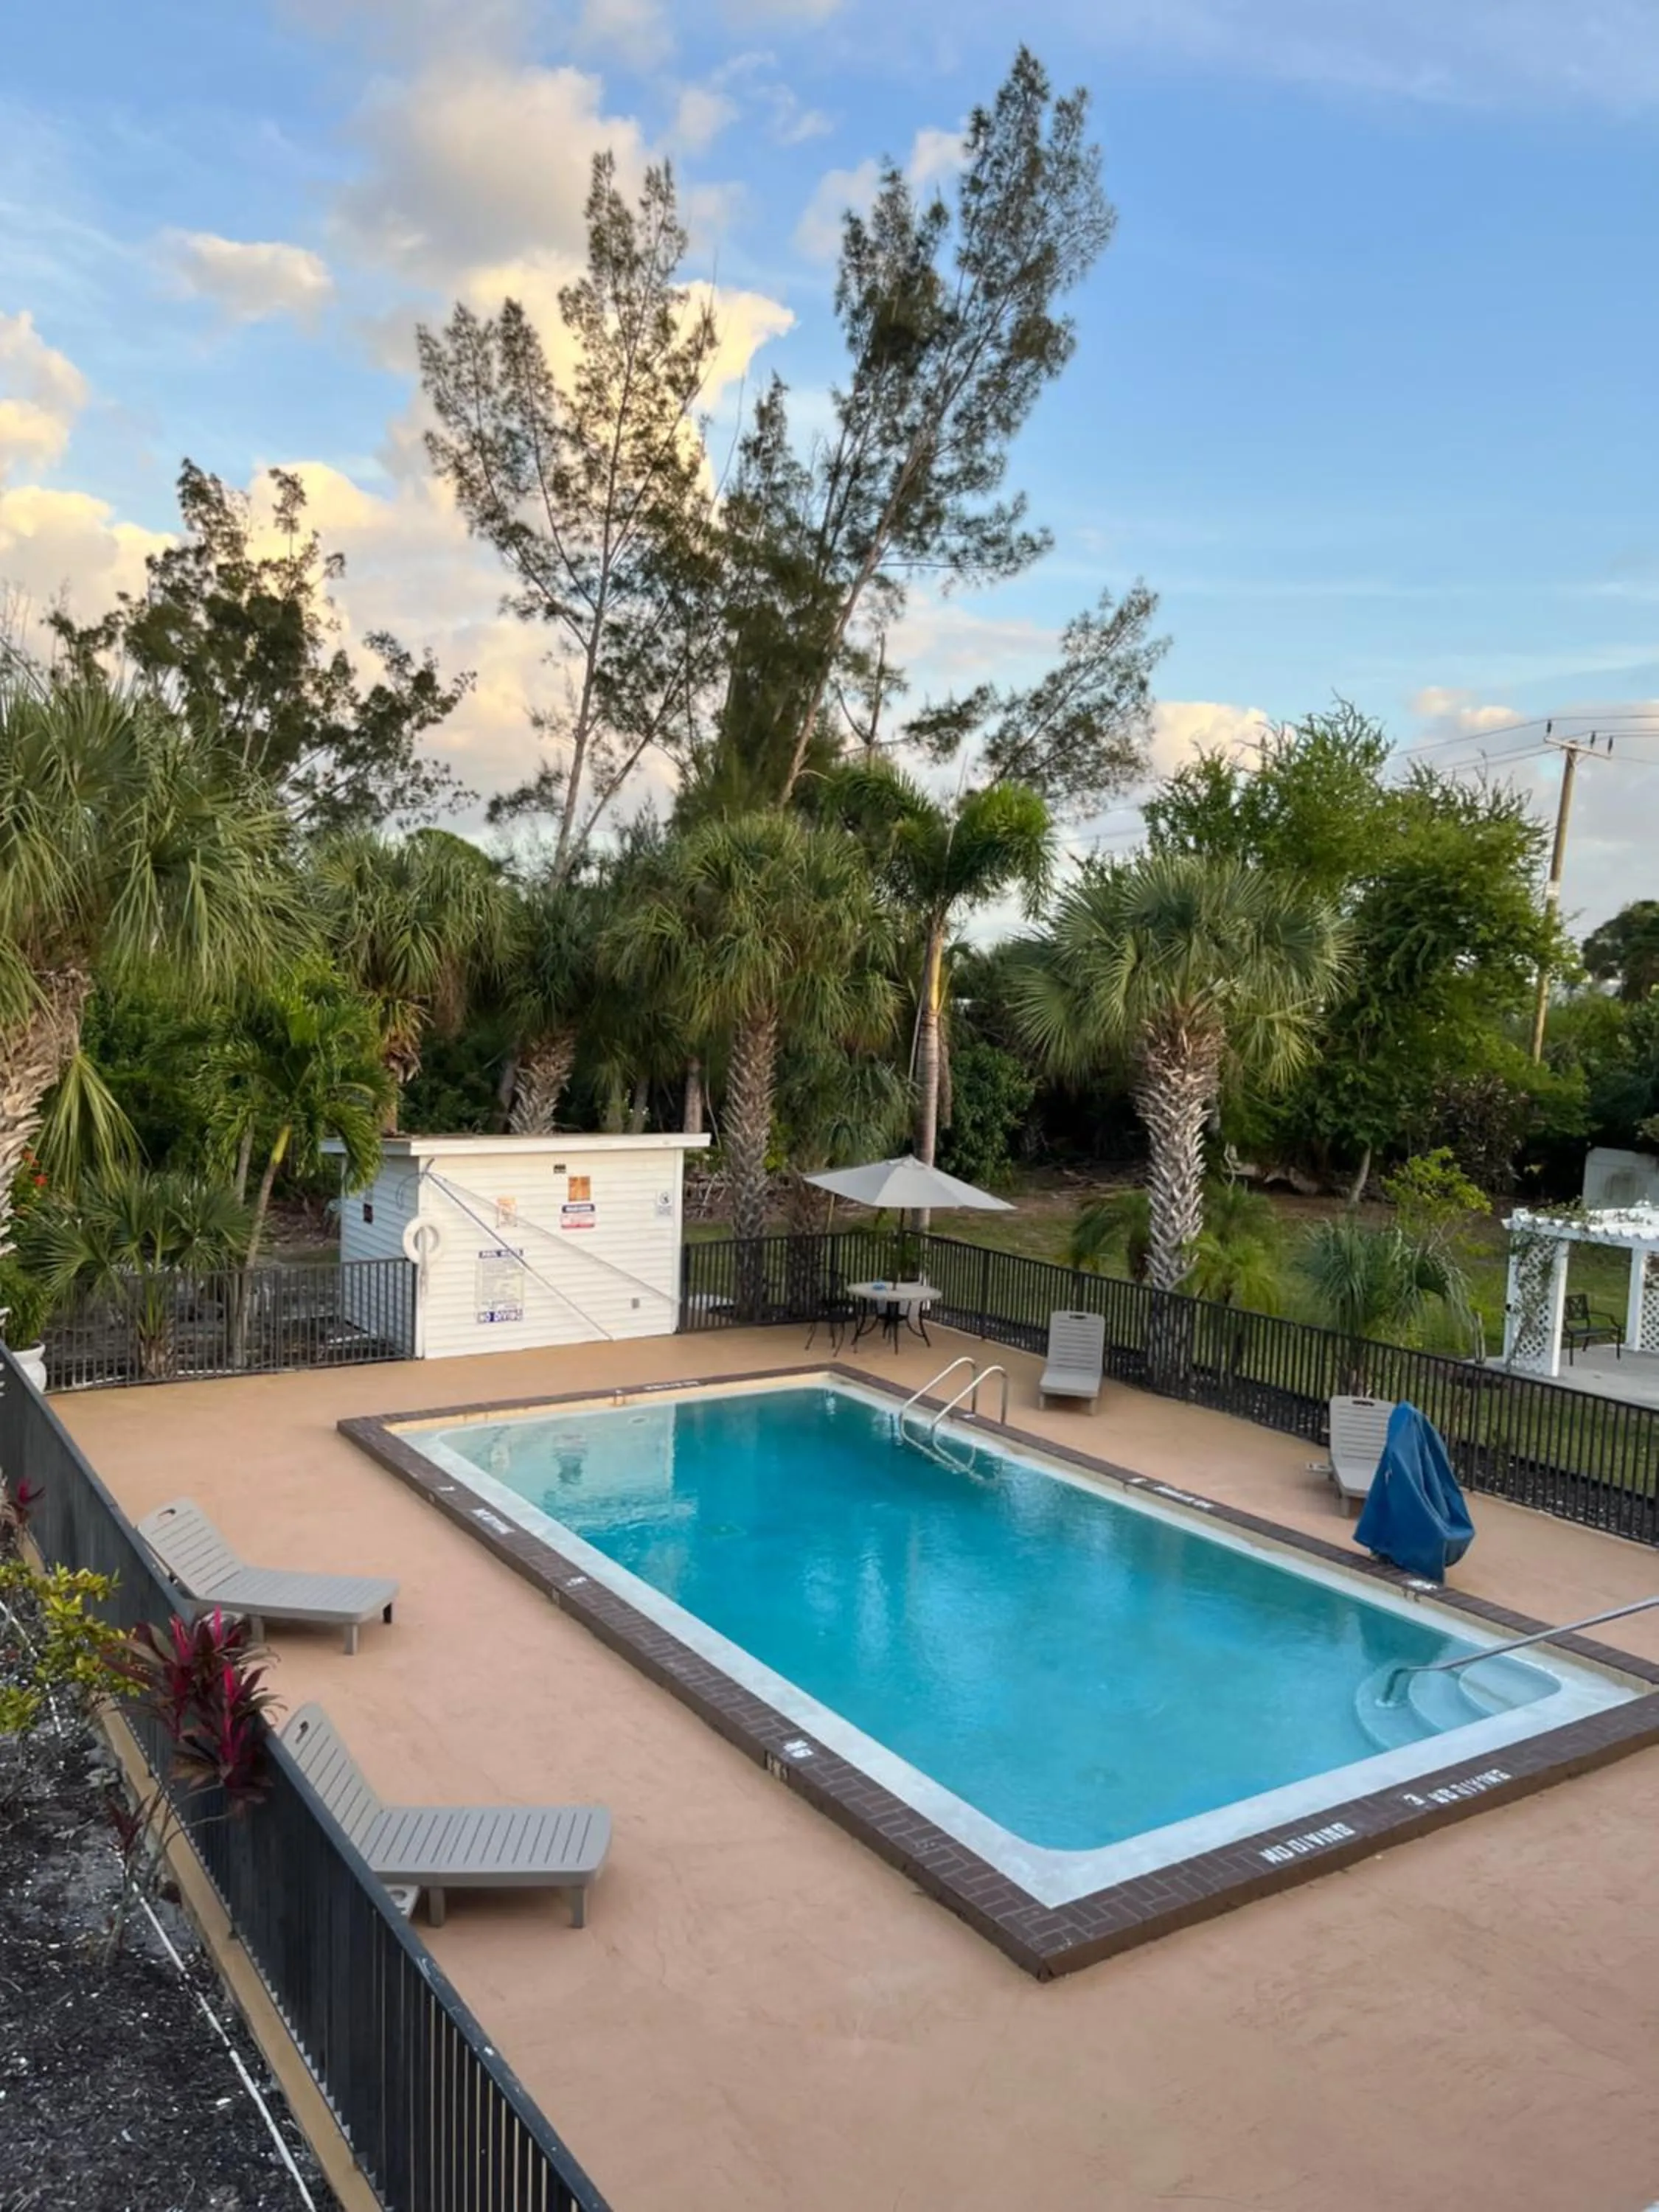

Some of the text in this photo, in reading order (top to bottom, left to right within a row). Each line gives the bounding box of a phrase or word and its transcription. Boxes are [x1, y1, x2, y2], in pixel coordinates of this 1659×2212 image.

[1427, 1788, 1459, 1804] NO
[1259, 1822, 1357, 1865] NO DIVING
